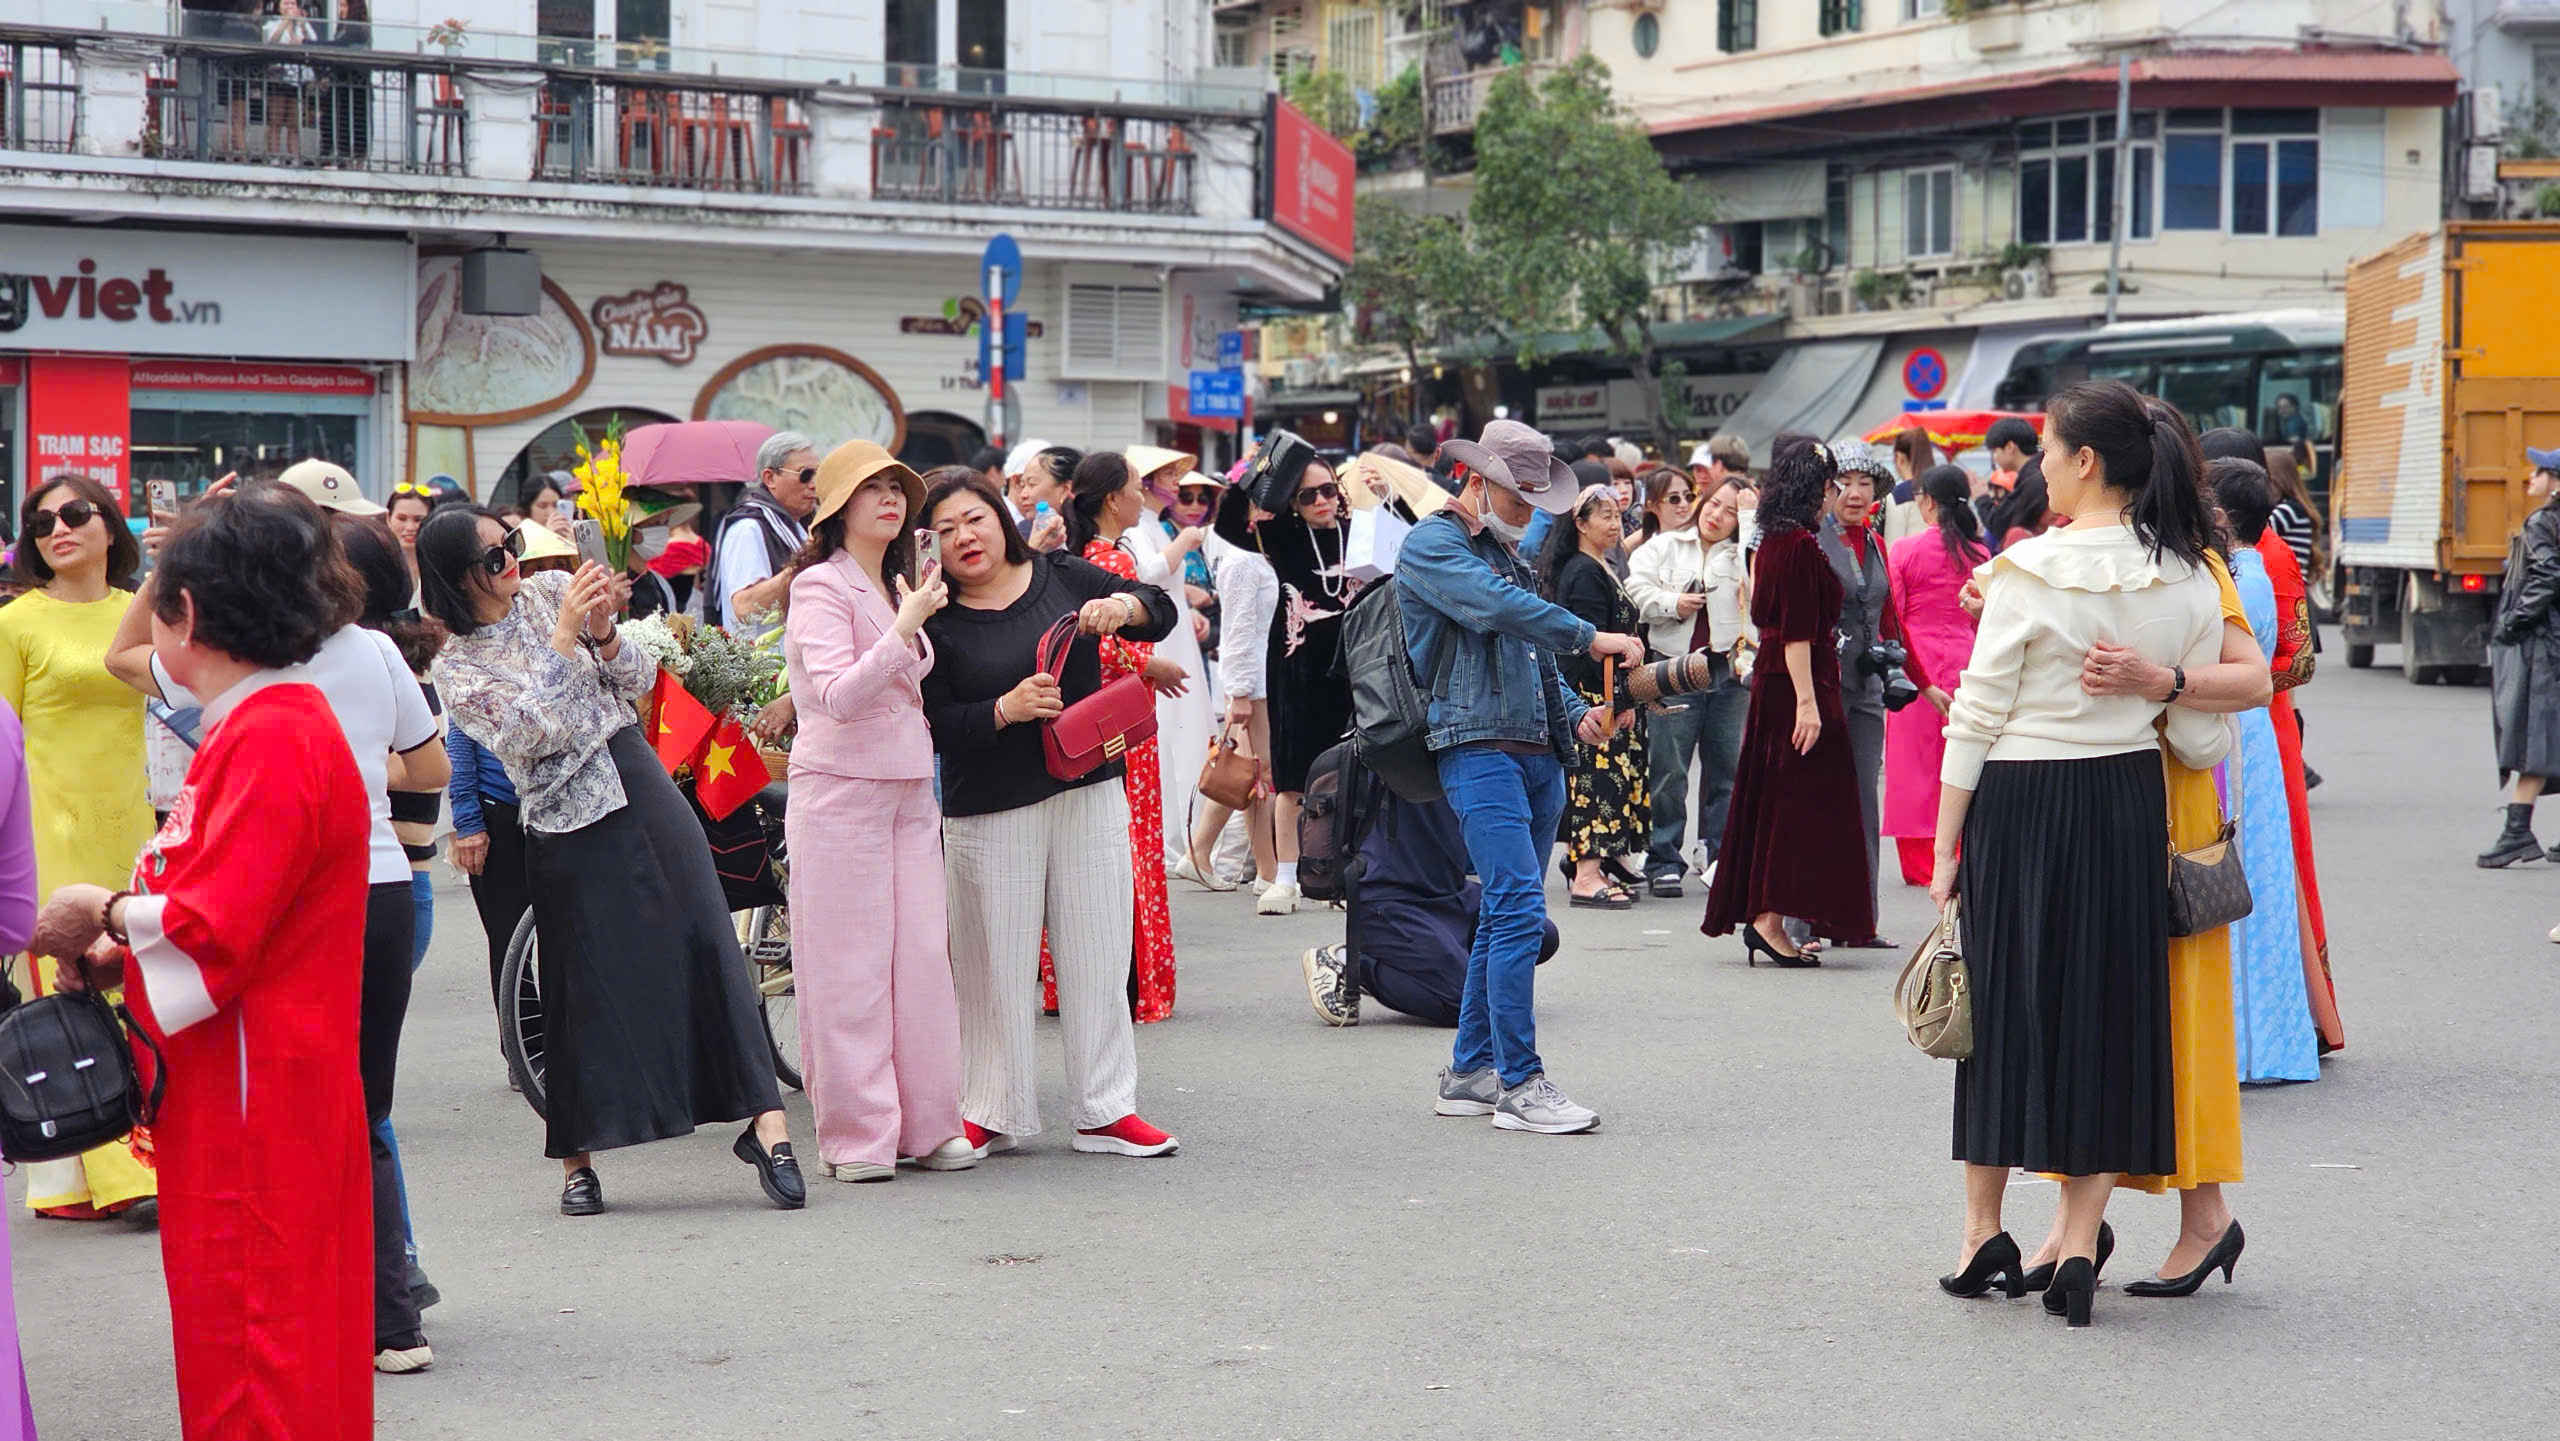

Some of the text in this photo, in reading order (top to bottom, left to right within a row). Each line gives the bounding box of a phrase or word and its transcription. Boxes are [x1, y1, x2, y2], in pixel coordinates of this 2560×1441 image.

[133, 371, 366, 388] Affordable Phones And Tech Gadgets Store
[37, 434, 123, 461] TRẠM SẠC
